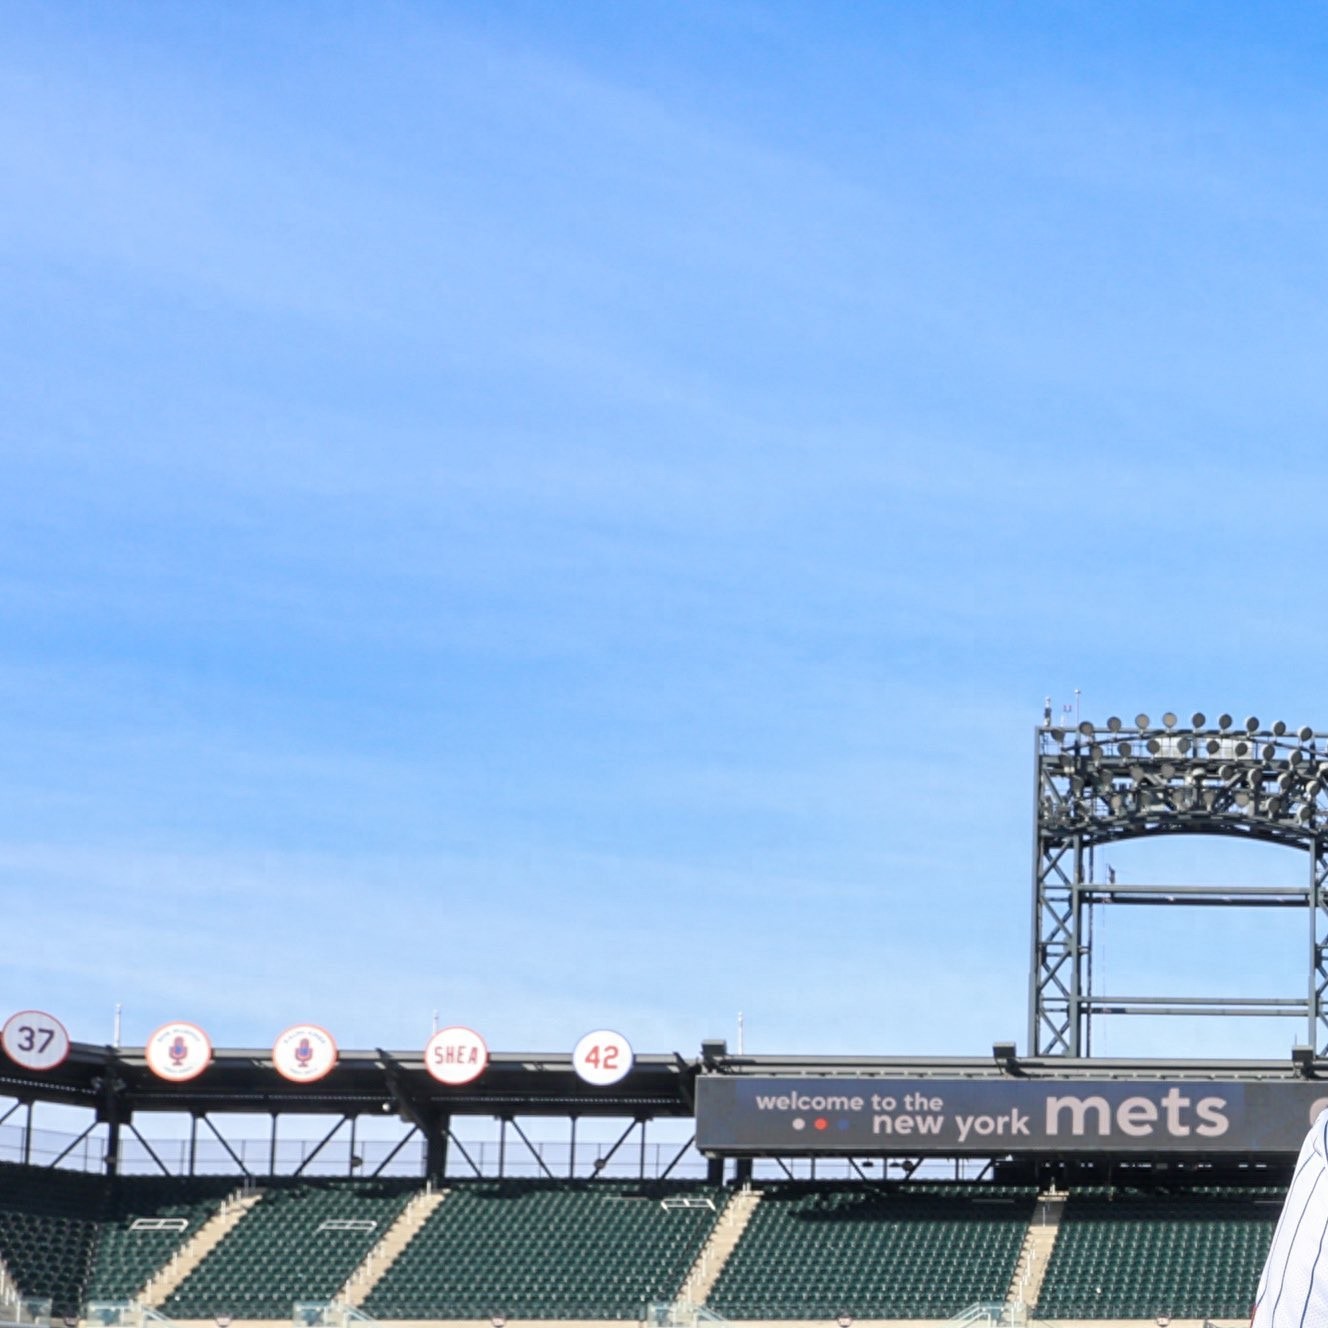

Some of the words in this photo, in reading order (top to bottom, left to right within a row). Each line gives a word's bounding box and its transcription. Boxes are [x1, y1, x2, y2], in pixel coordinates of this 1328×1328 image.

[16, 1026, 56, 1054] 37
[433, 1046, 479, 1066] SHEA
[584, 1045, 620, 1070] 42
[756, 1091, 864, 1111] welcome
[871, 1093, 897, 1111] to
[902, 1091, 944, 1112] the
[1045, 1086, 1230, 1138] mets
[872, 1112, 944, 1135] new
[955, 1108, 1030, 1142] york
